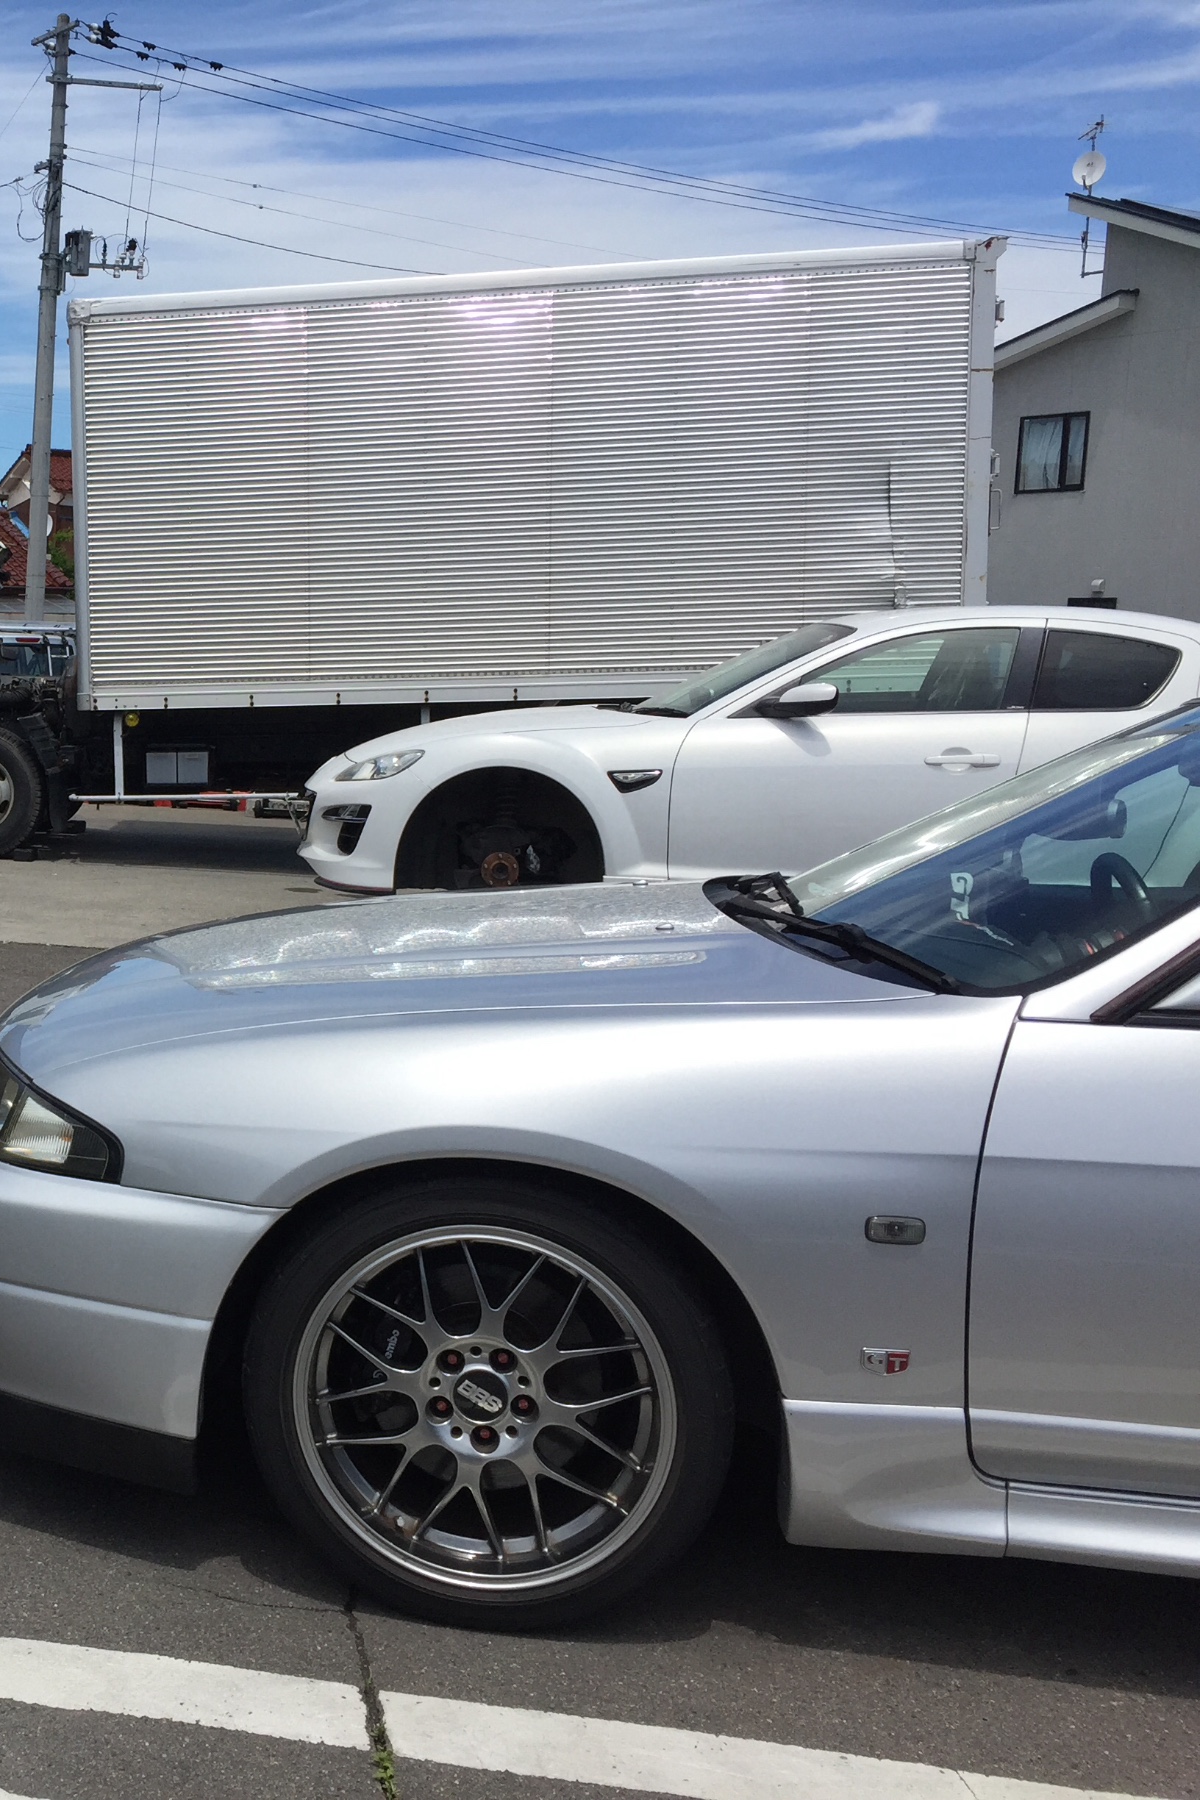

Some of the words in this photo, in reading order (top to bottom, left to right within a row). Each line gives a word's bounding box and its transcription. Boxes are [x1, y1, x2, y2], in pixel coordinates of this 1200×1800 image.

[384, 1329, 400, 1360] embo
[866, 1353, 907, 1371] GT
[456, 1379, 503, 1414] BBS
